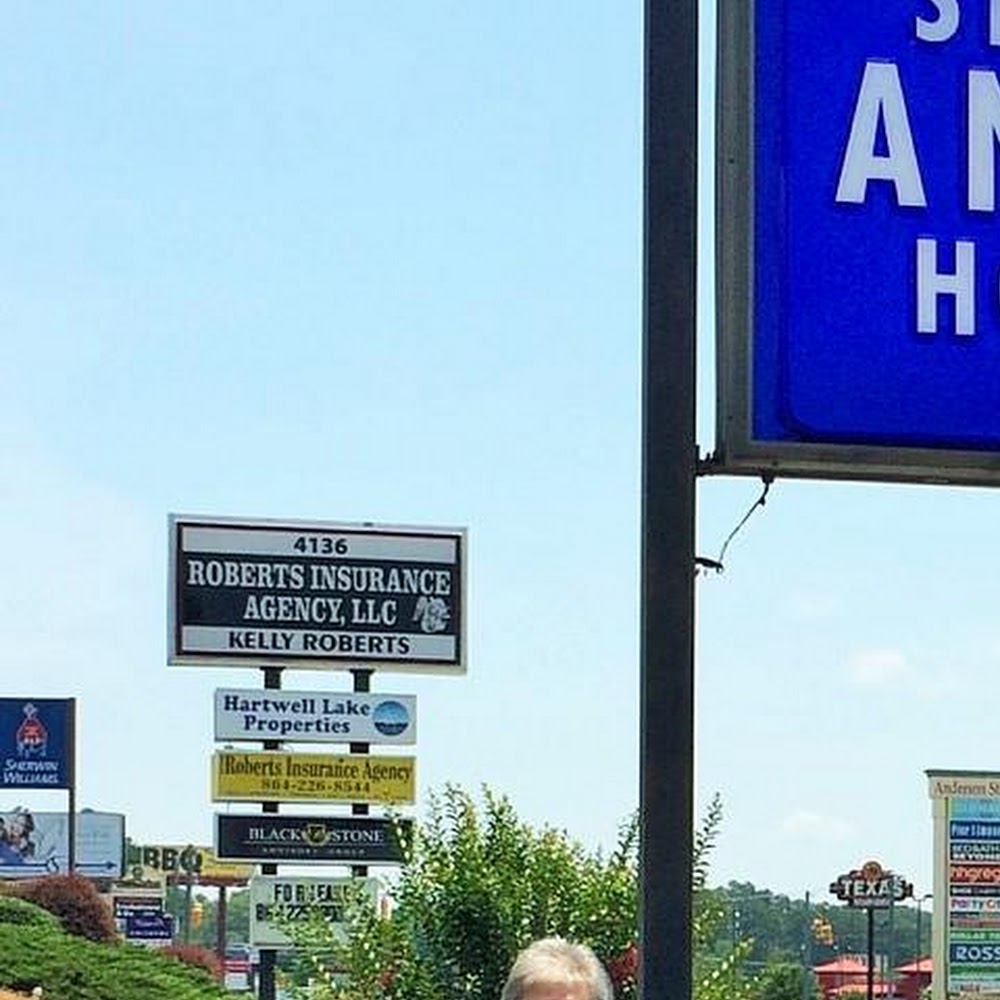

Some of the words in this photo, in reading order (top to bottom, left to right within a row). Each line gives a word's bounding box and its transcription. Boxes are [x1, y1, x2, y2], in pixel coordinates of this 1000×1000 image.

[293, 537, 348, 555] 4136
[187, 560, 305, 589] ROBERTS
[310, 565, 451, 595] INSURANCE
[243, 595, 346, 626] AGENCY,
[351, 599, 397, 625] LLC
[228, 631, 294, 650] KELLY
[302, 634, 410, 654] ROBERTS
[224, 695, 316, 715] Hartwell
[322, 699, 370, 716] Lake
[244, 716, 350, 735] Properties
[225, 756, 282, 777] Roberts
[286, 757, 359, 779] Insurance
[364, 759, 412, 783] Agency
[249, 828, 301, 841] BLACK
[332, 829, 385, 843] STONE
[143, 846, 203, 873] BBQ
[842, 878, 905, 898] TEXAS
